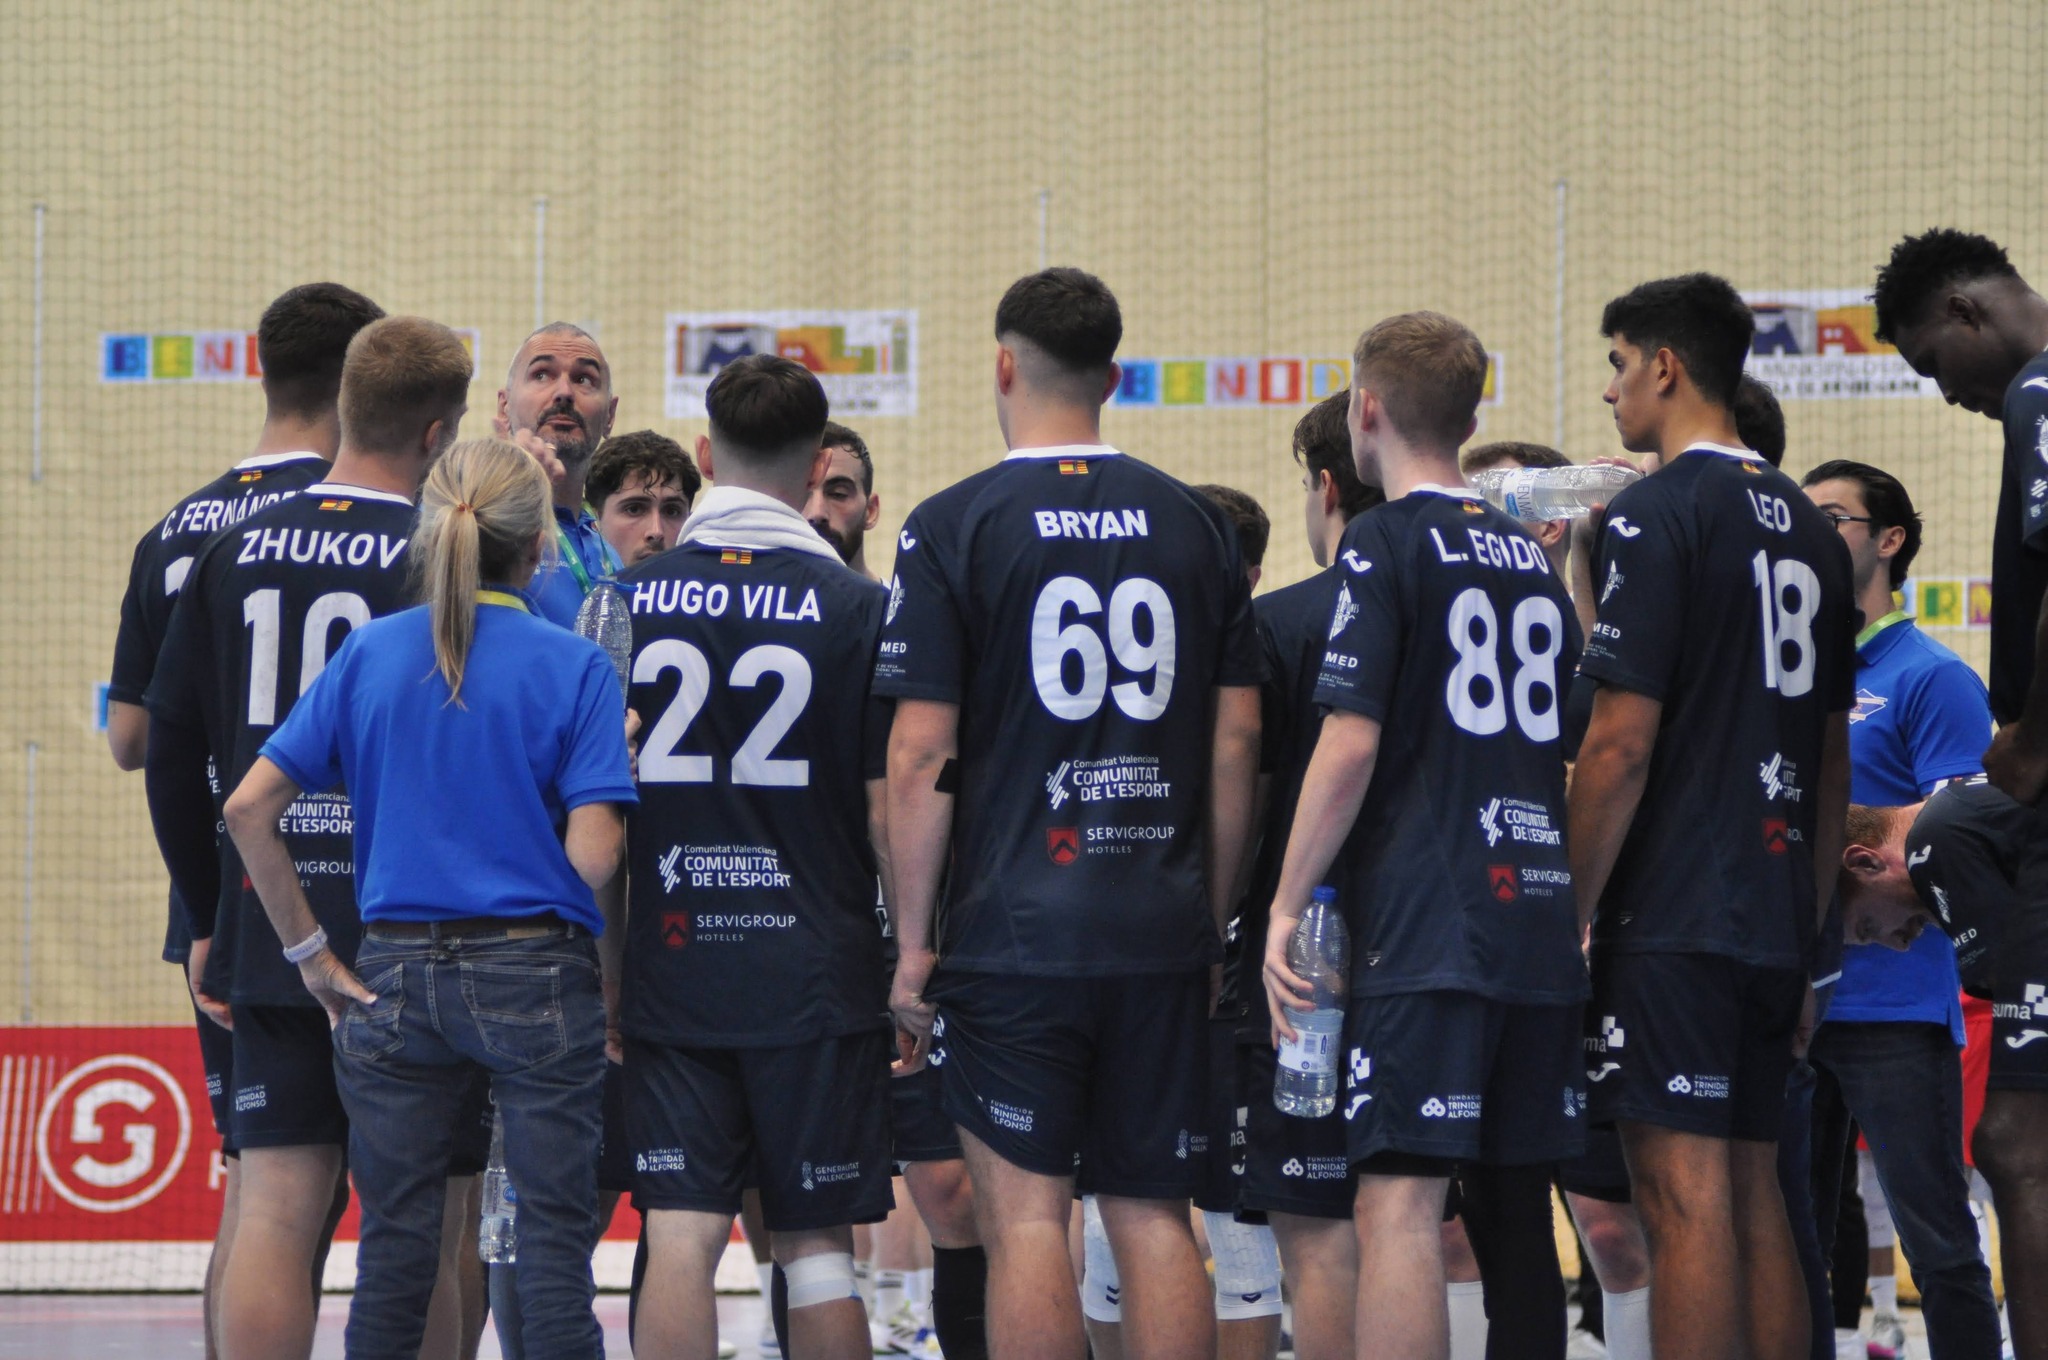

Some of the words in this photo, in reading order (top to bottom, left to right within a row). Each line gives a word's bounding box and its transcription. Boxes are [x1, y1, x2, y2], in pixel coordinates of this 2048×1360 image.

[161, 510, 177, 541] C.
[177, 487, 297, 533] FERNÁN
[1748, 489, 1792, 533] LEO
[1033, 508, 1149, 540] BRYAN
[236, 528, 408, 570] ZHUKOV
[1430, 528, 1468, 563] L.
[1467, 528, 1550, 575] EGIDO
[631, 578, 730, 617] HUGO
[740, 584, 822, 622] VILA
[1592, 622, 1621, 639] MED
[1752, 549, 1821, 698] 18
[880, 641, 907, 653] MED
[1030, 575, 1177, 721] 69
[243, 588, 373, 726] 10
[1325, 651, 1358, 668] MED
[1446, 587, 1563, 743] 88
[631, 638, 813, 787] 22
[1073, 756, 1117, 769] Comunitat
[1119, 755, 1159, 764] Valenciana
[1073, 767, 1160, 786] COMUNITAT
[1080, 787, 1102, 801] DE
[1105, 783, 1171, 799] L'ESPORT
[293, 818, 355, 833] L'ESPOR
[1087, 826, 1175, 841] SERVIGROUP
[1512, 825, 1528, 840] DE
[684, 844, 731, 854] Comunitat
[733, 844, 777, 856] Valenciana
[1088, 845, 1132, 855] HOTELES
[294, 861, 355, 874] VIGROU
[684, 856, 778, 871] COMUNITAT
[692, 872, 713, 887] DE
[718, 872, 791, 887] L'ESPORT
[1521, 868, 1572, 885] SERVIGROUP
[696, 915, 797, 928] SERVIGROUP
[696, 933, 744, 942] HOTELES
[1952, 928, 1978, 949] MED
[990, 1106, 1033, 1124] TRINIDAD
[1448, 1110, 1481, 1118] ALFONS
[992, 1116, 1032, 1132] LFONSO
[649, 1162, 685, 1171] ALFONSO
[1307, 1163, 1348, 1171] TRINIDAD
[1307, 1171, 1348, 1180] ALFONSO
